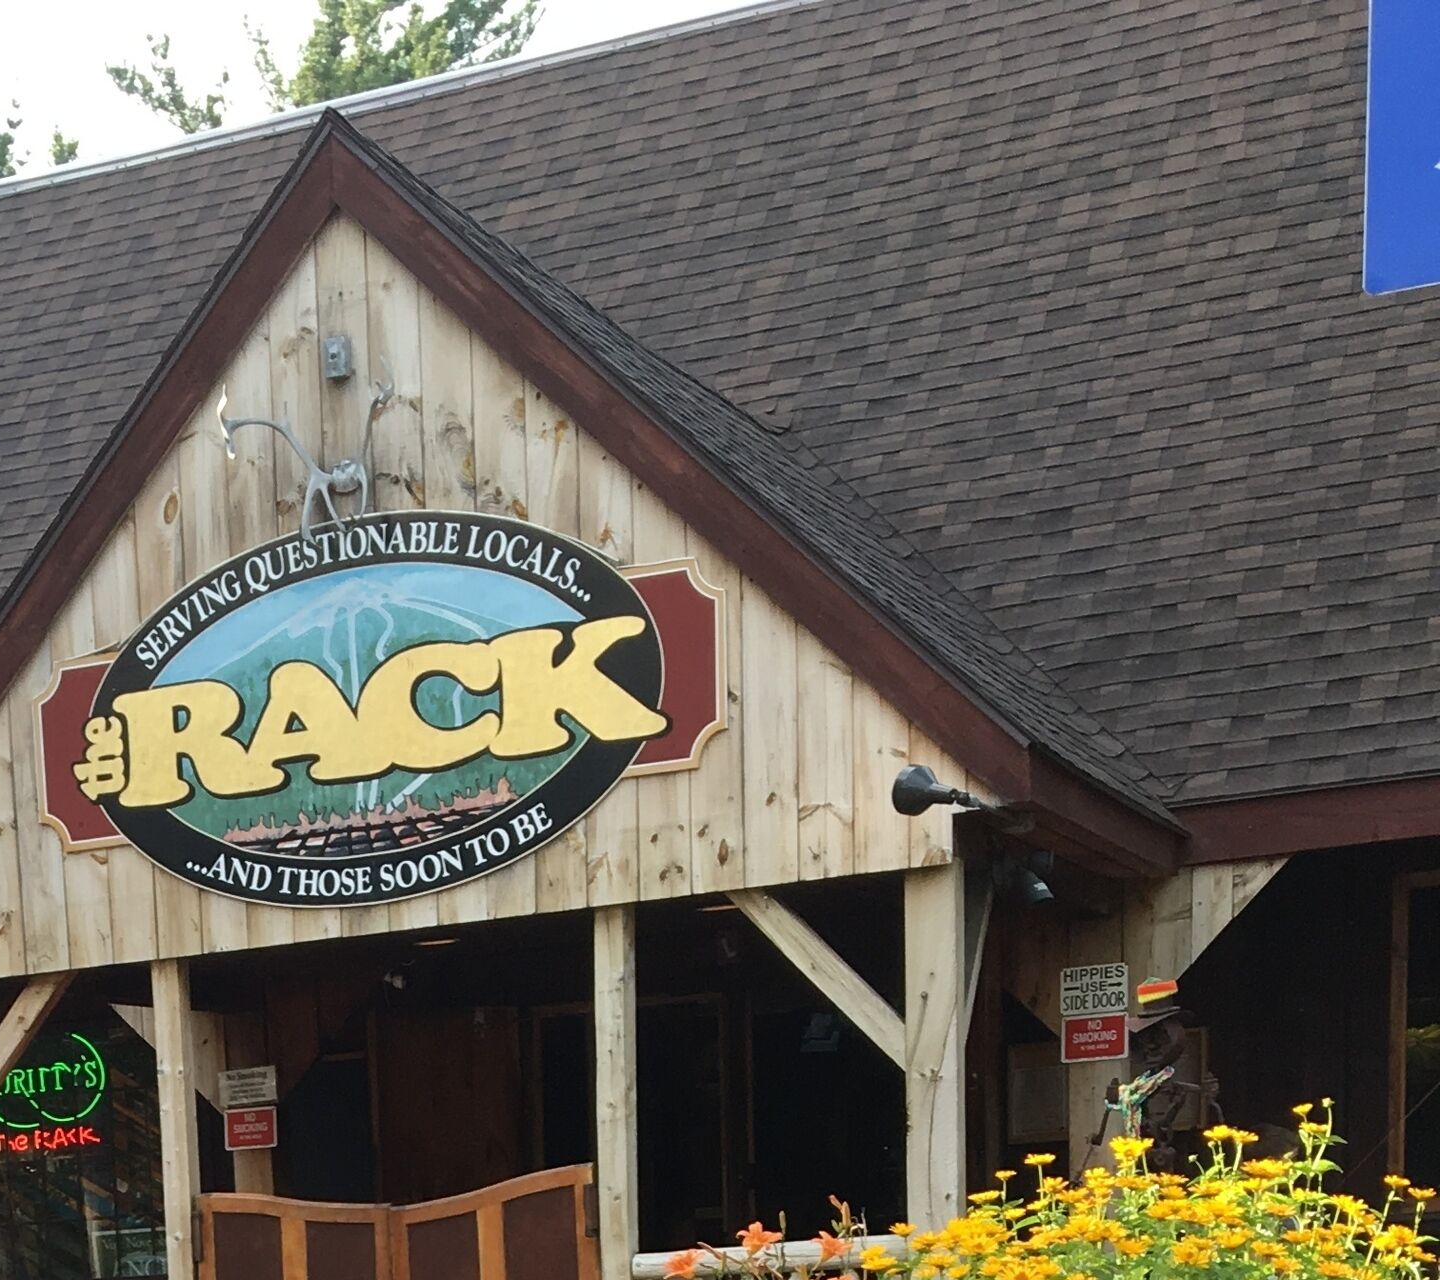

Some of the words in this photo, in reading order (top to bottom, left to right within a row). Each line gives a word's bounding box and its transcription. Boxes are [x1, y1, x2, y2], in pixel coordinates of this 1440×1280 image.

[136, 570, 241, 669] SERVING
[245, 521, 460, 590] QUESTIONABLE
[465, 527, 592, 602] LOCALS...
[112, 615, 667, 807] RACK
[74, 714, 128, 801] the
[277, 866, 372, 897] THOSE
[379, 847, 461, 883] SOON
[463, 830, 510, 869] TO
[510, 802, 553, 854] BE
[1063, 965, 1125, 983] HIPPIES
[1080, 980, 1108, 993] USE
[1062, 994, 1089, 1011] SIDE
[1092, 991, 1126, 1008] DOOR
[1087, 1020, 1102, 1031] NO
[1072, 1029, 1117, 1044] SMOKING
